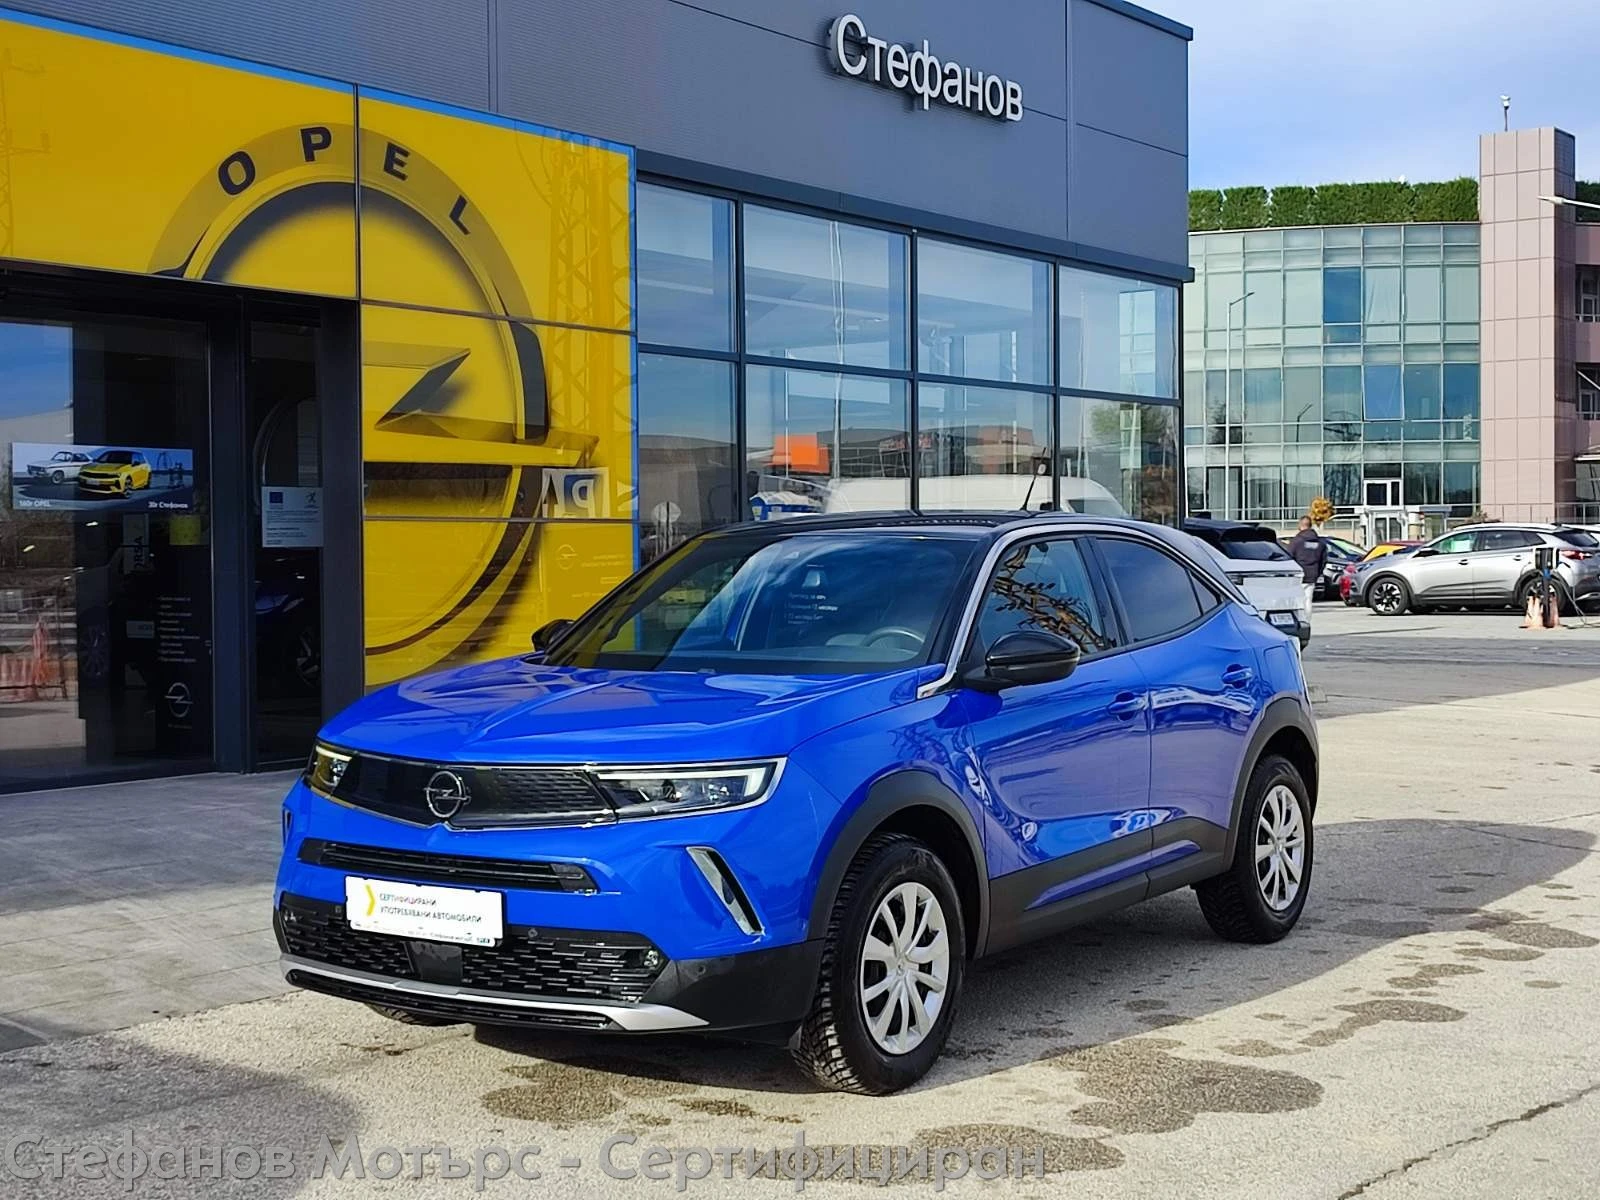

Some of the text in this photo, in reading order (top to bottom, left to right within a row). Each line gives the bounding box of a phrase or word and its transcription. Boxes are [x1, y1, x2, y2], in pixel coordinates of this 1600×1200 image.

[836, 14, 1024, 122] Стефанов
[217, 126, 471, 236] OPEL
[380, 893, 437, 906] СЕРТИФИЦИРАНИ
[432, 912, 482, 923] АВТОМОБИЛИ
